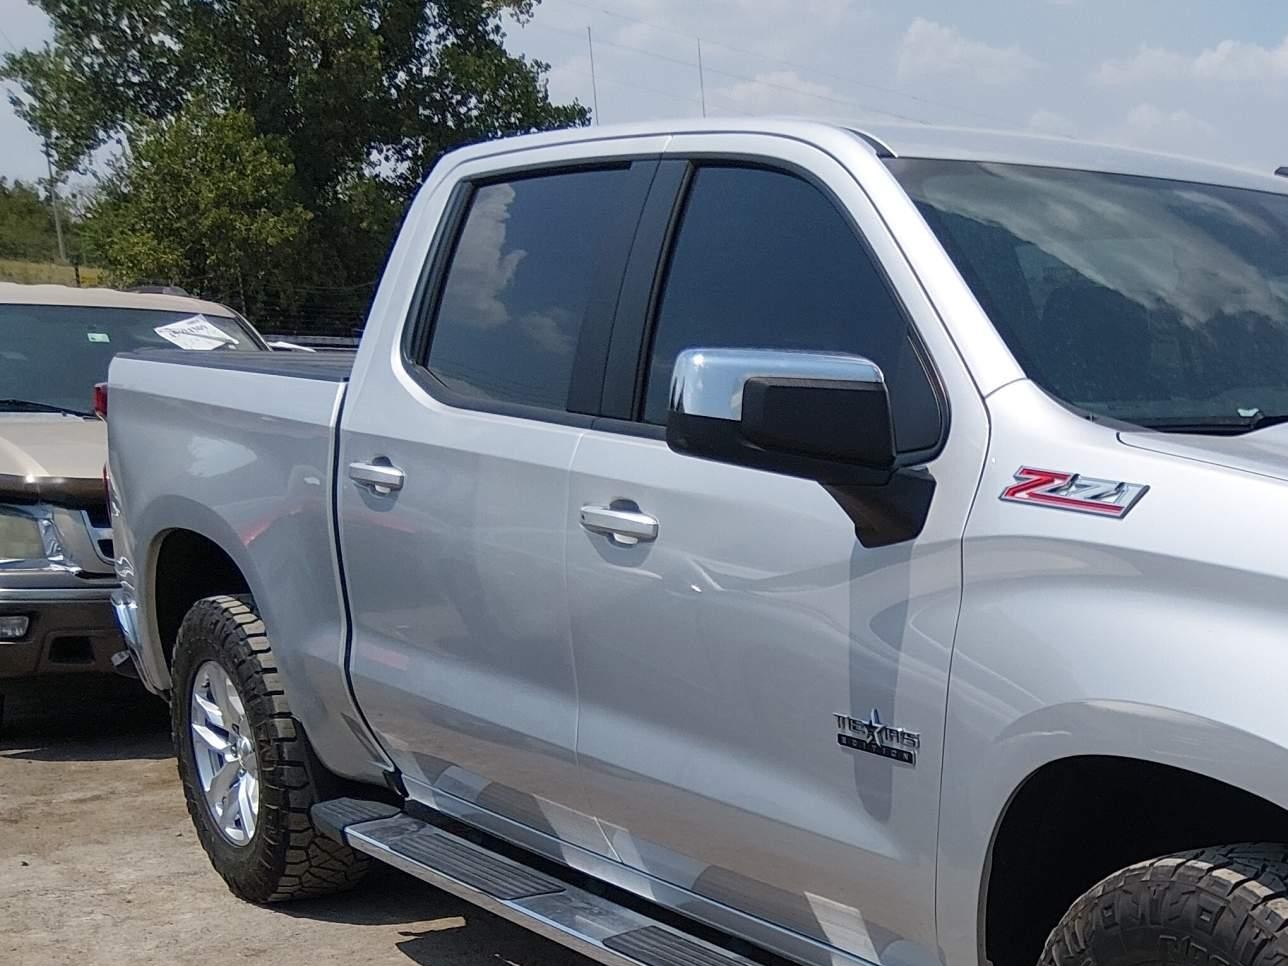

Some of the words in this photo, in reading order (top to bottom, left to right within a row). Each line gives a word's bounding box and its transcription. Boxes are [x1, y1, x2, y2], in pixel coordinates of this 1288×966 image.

[998, 465, 1151, 519] Z71
[832, 709, 921, 749] TEXAS
[840, 735, 911, 761] EDITION
